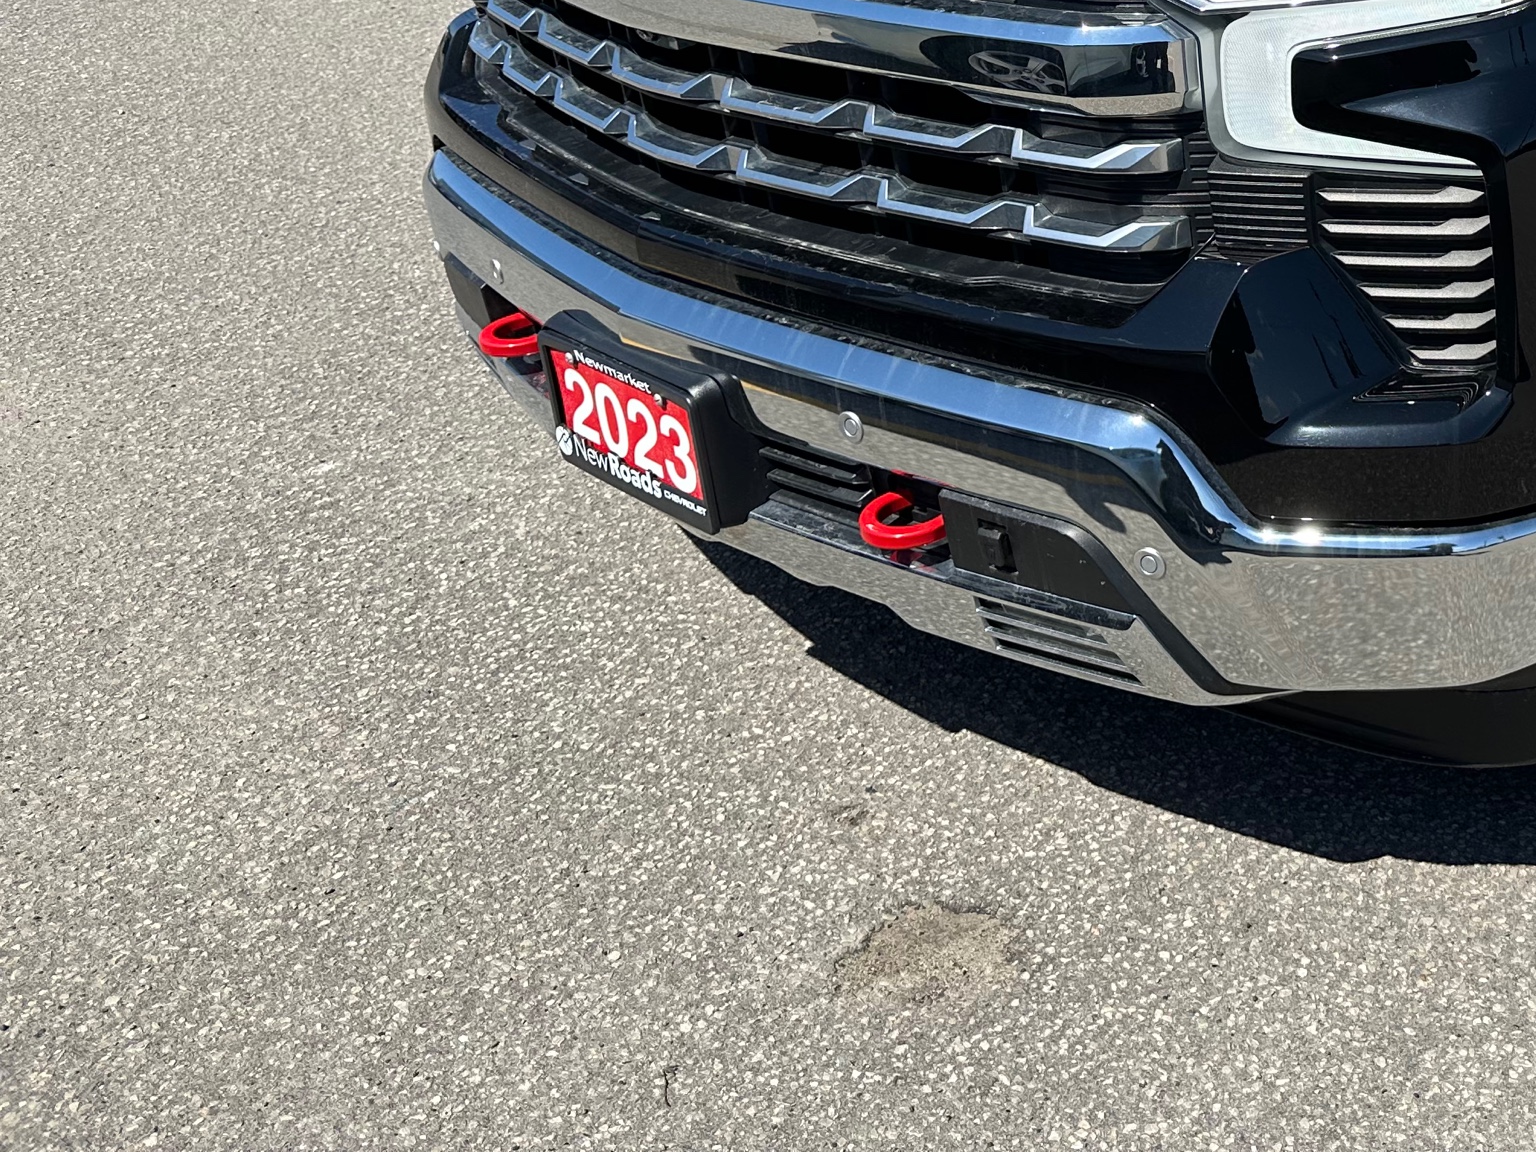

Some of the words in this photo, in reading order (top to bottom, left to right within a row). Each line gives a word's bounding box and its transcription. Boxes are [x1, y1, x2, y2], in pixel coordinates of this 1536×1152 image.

[573, 349, 652, 394] Newmarket
[563, 368, 697, 494] 2023
[663, 489, 707, 517] CHEVROLET
